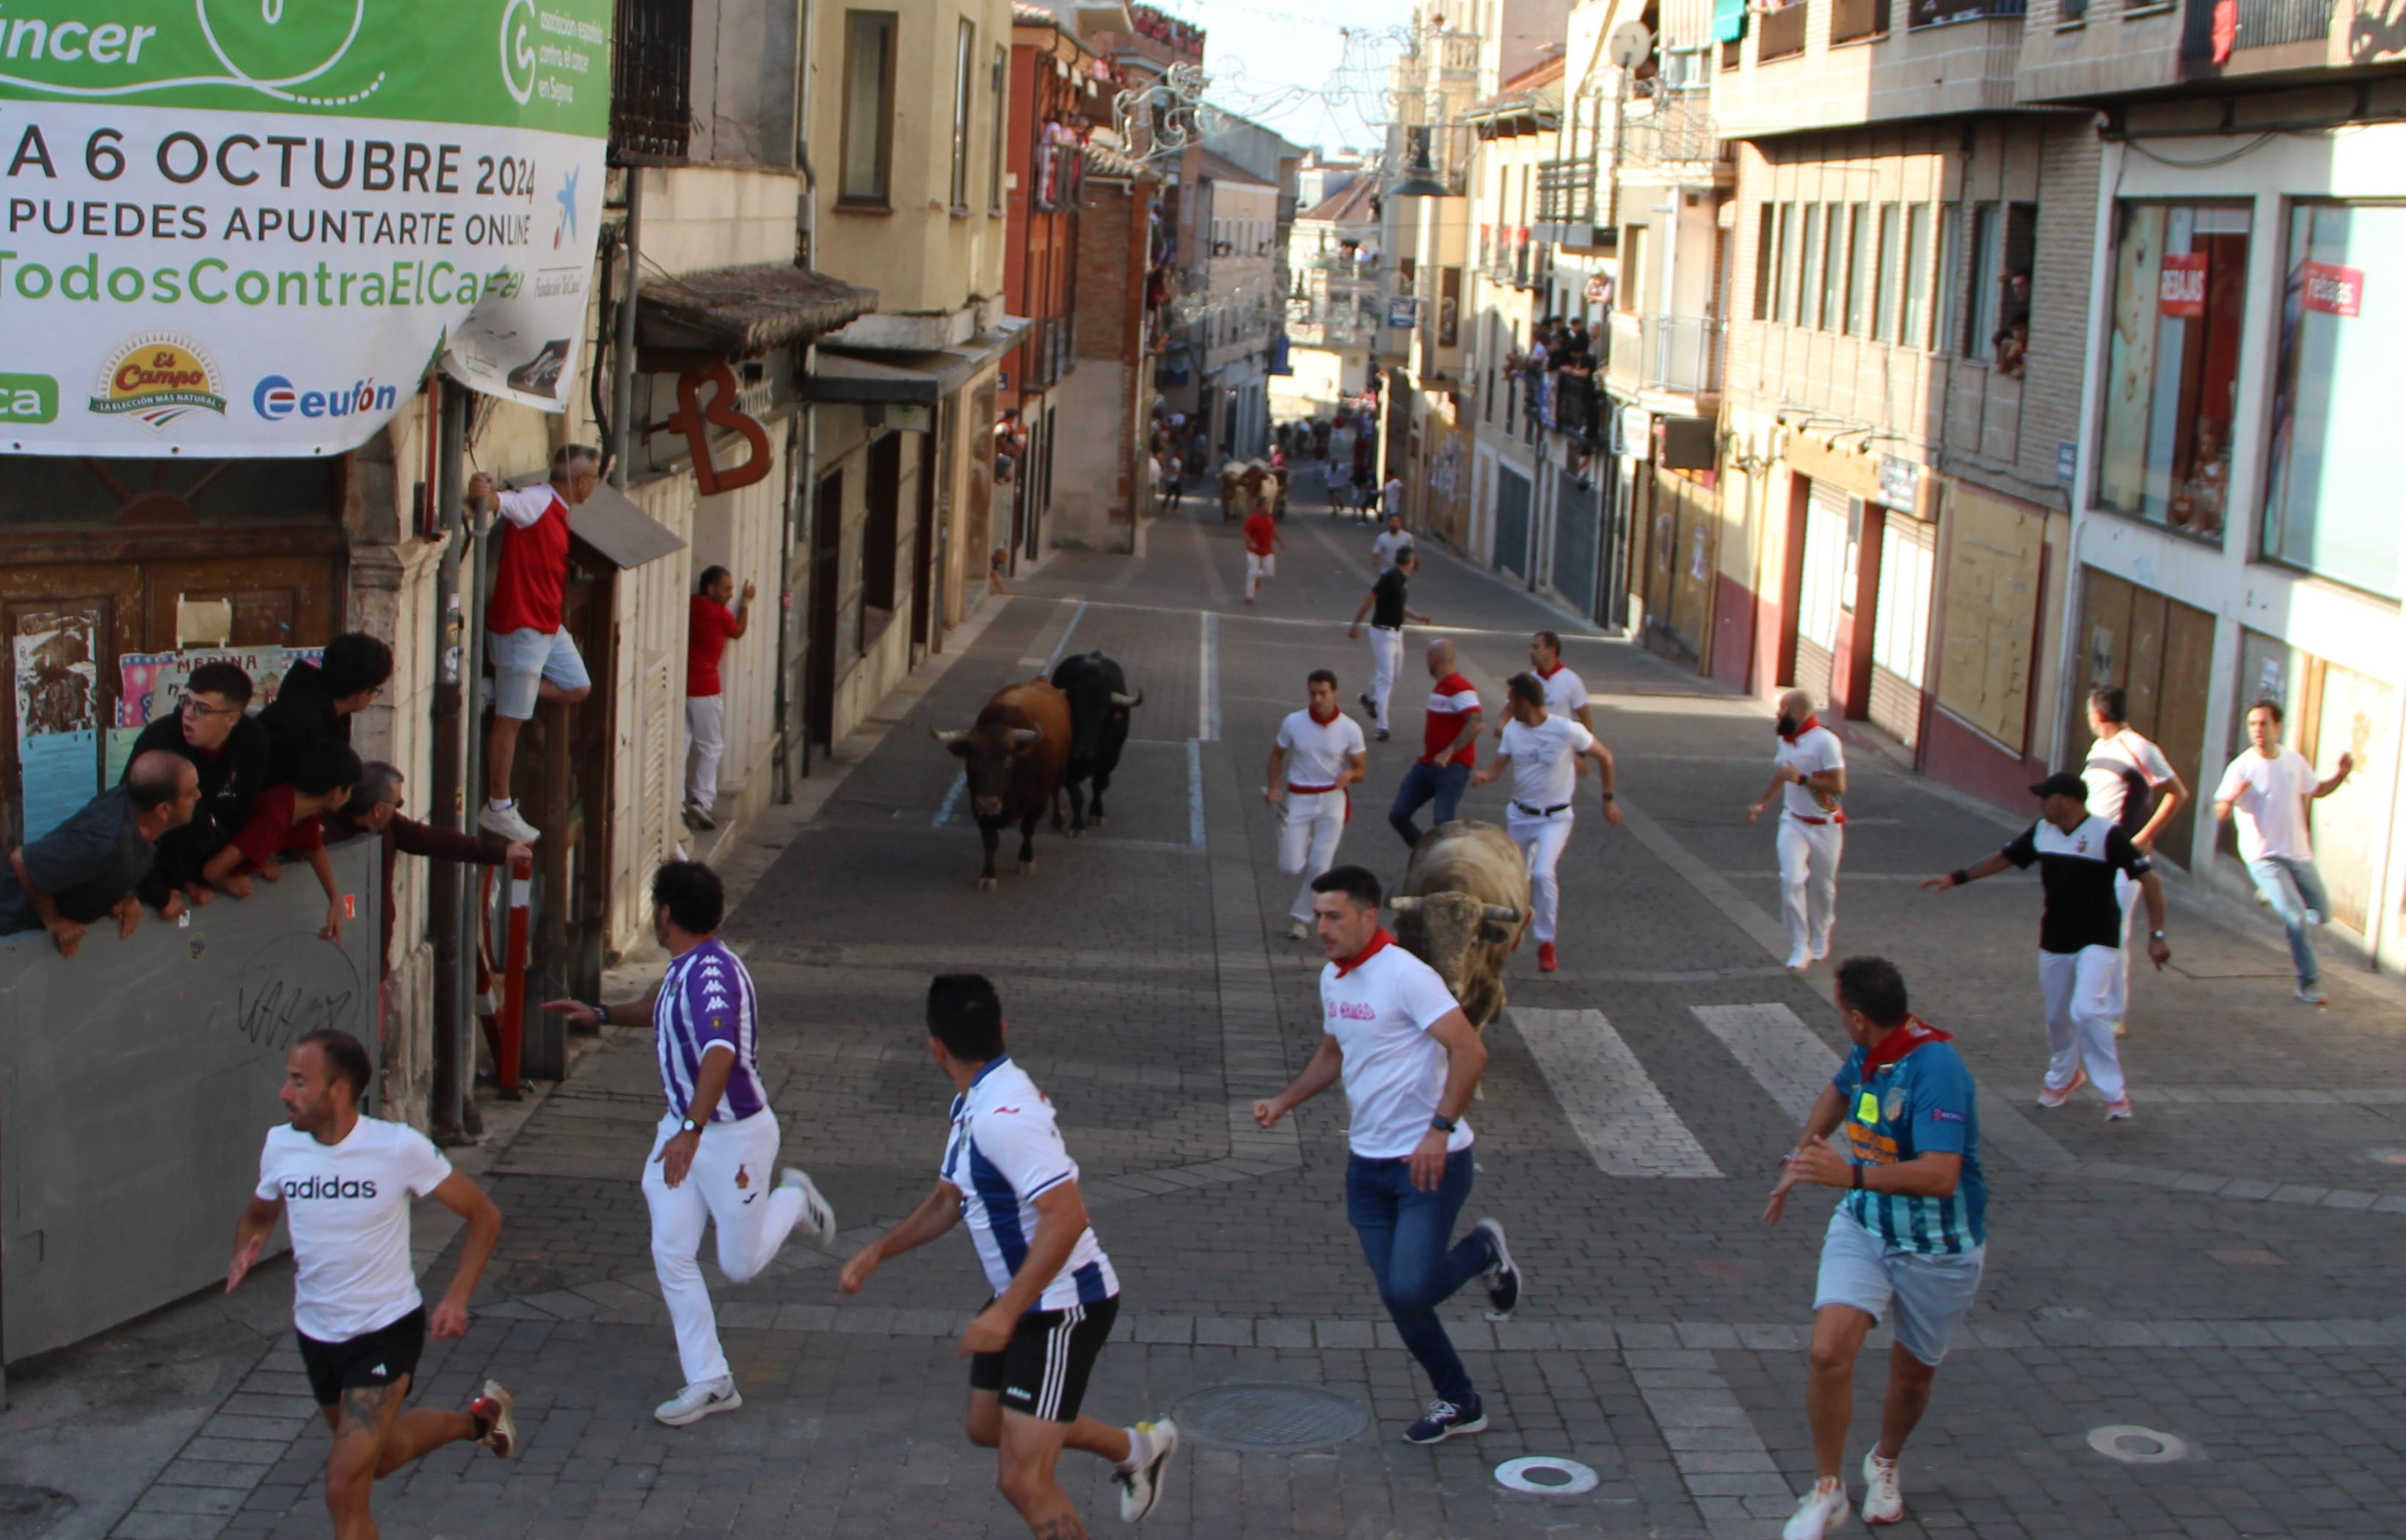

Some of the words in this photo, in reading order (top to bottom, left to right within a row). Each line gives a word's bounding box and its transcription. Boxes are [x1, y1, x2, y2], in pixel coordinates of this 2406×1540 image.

[85, 127, 126, 181] 6
[156, 130, 462, 194] OCTUBRE
[476, 156, 536, 203] 2024
[10, 197, 208, 239] PUEDES
[223, 206, 456, 246] APUNTARTE
[465, 214, 531, 246] ONLINE
[153, 351, 176, 368] El
[116, 363, 205, 391] Campo
[100, 402, 111, 411] LA
[112, 395, 153, 410] ELECCIÓN
[156, 394, 175, 403] MÁS
[177, 393, 216, 406] NATURAL
[300, 376, 397, 417] eufón
[284, 1175, 377, 1199] adidas
